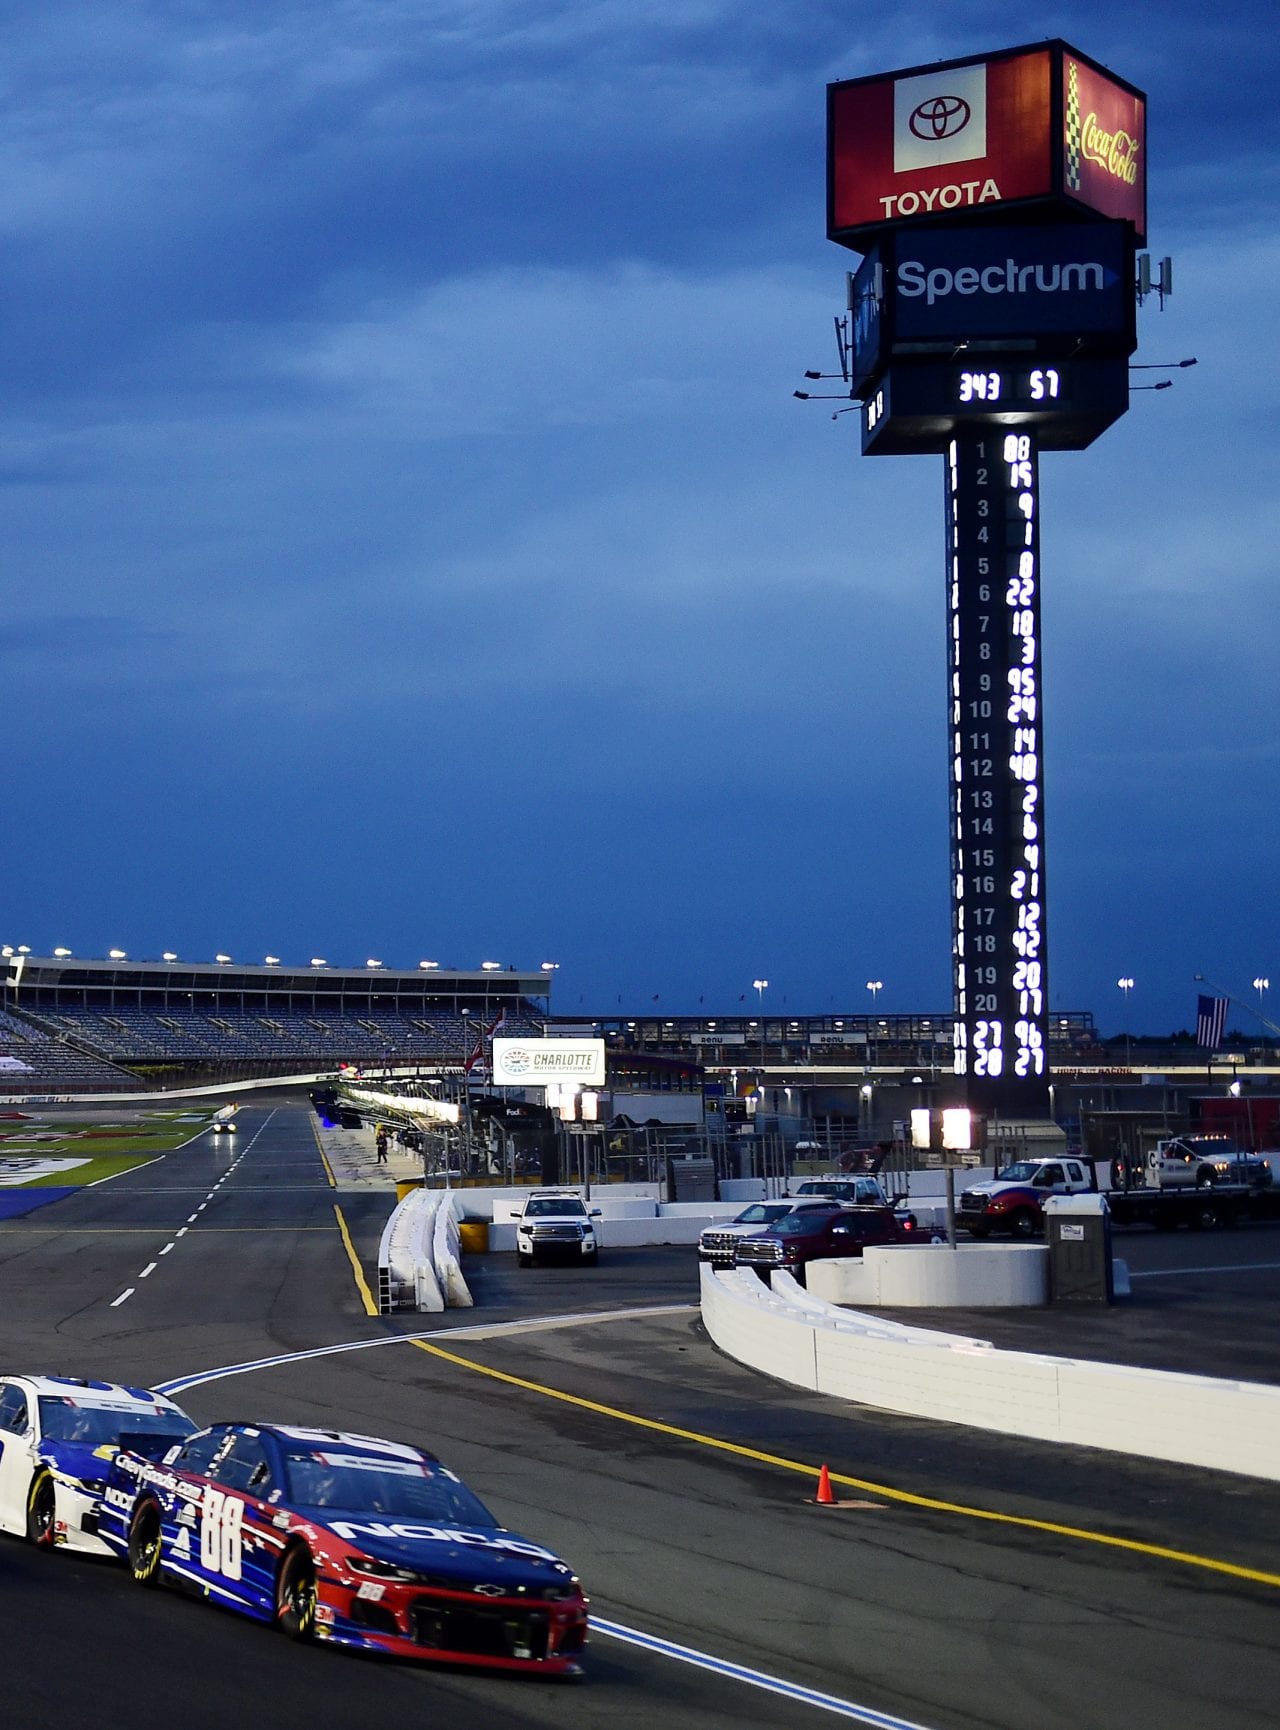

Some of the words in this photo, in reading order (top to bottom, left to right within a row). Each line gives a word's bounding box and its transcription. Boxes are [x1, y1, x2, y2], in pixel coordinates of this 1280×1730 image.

[879, 178, 1002, 219] TOYOTA
[897, 258, 1105, 306] Spectrum
[959, 372, 1000, 402] 343
[1030, 369, 1059, 400] 57
[977, 443, 986, 458] 1
[1004, 435, 1031, 463] 88
[976, 468, 988, 485] 2
[977, 499, 989, 517] 3
[1018, 493, 1034, 519] 9
[977, 526, 989, 543] 4
[1024, 522, 1033, 546] 1
[978, 558, 989, 574] 5
[1019, 551, 1034, 579] 8
[979, 585, 990, 602] 6
[1006, 578, 1034, 606] 22
[979, 616, 990, 633] 7
[1013, 610, 1034, 637] 18
[980, 643, 991, 660] 8
[1021, 636, 1036, 664] 3
[980, 675, 991, 691] 9
[1008, 668, 1036, 696] 95
[969, 701, 992, 718] 10
[1007, 695, 1036, 723] 24
[970, 733, 989, 750] 11
[971, 759, 993, 776] 12
[1009, 753, 1038, 781] 48
[971, 791, 993, 808] 13
[1023, 784, 1038, 813] 2
[972, 818, 993, 835] 14
[972, 850, 994, 866] 15
[1024, 845, 1039, 870] 4
[973, 876, 995, 893] 16
[1010, 870, 1039, 899] 21
[973, 908, 995, 925] 17
[1018, 902, 1041, 930] 12
[974, 934, 996, 952] 18
[1012, 931, 1041, 958] 42
[975, 966, 997, 984] 19
[1012, 961, 1042, 990] 20
[975, 994, 997, 1012] 20
[534, 1054, 592, 1066] CHARLOTTE
[201, 1486, 245, 1581] 88
[327, 1520, 562, 1562] NOCO
